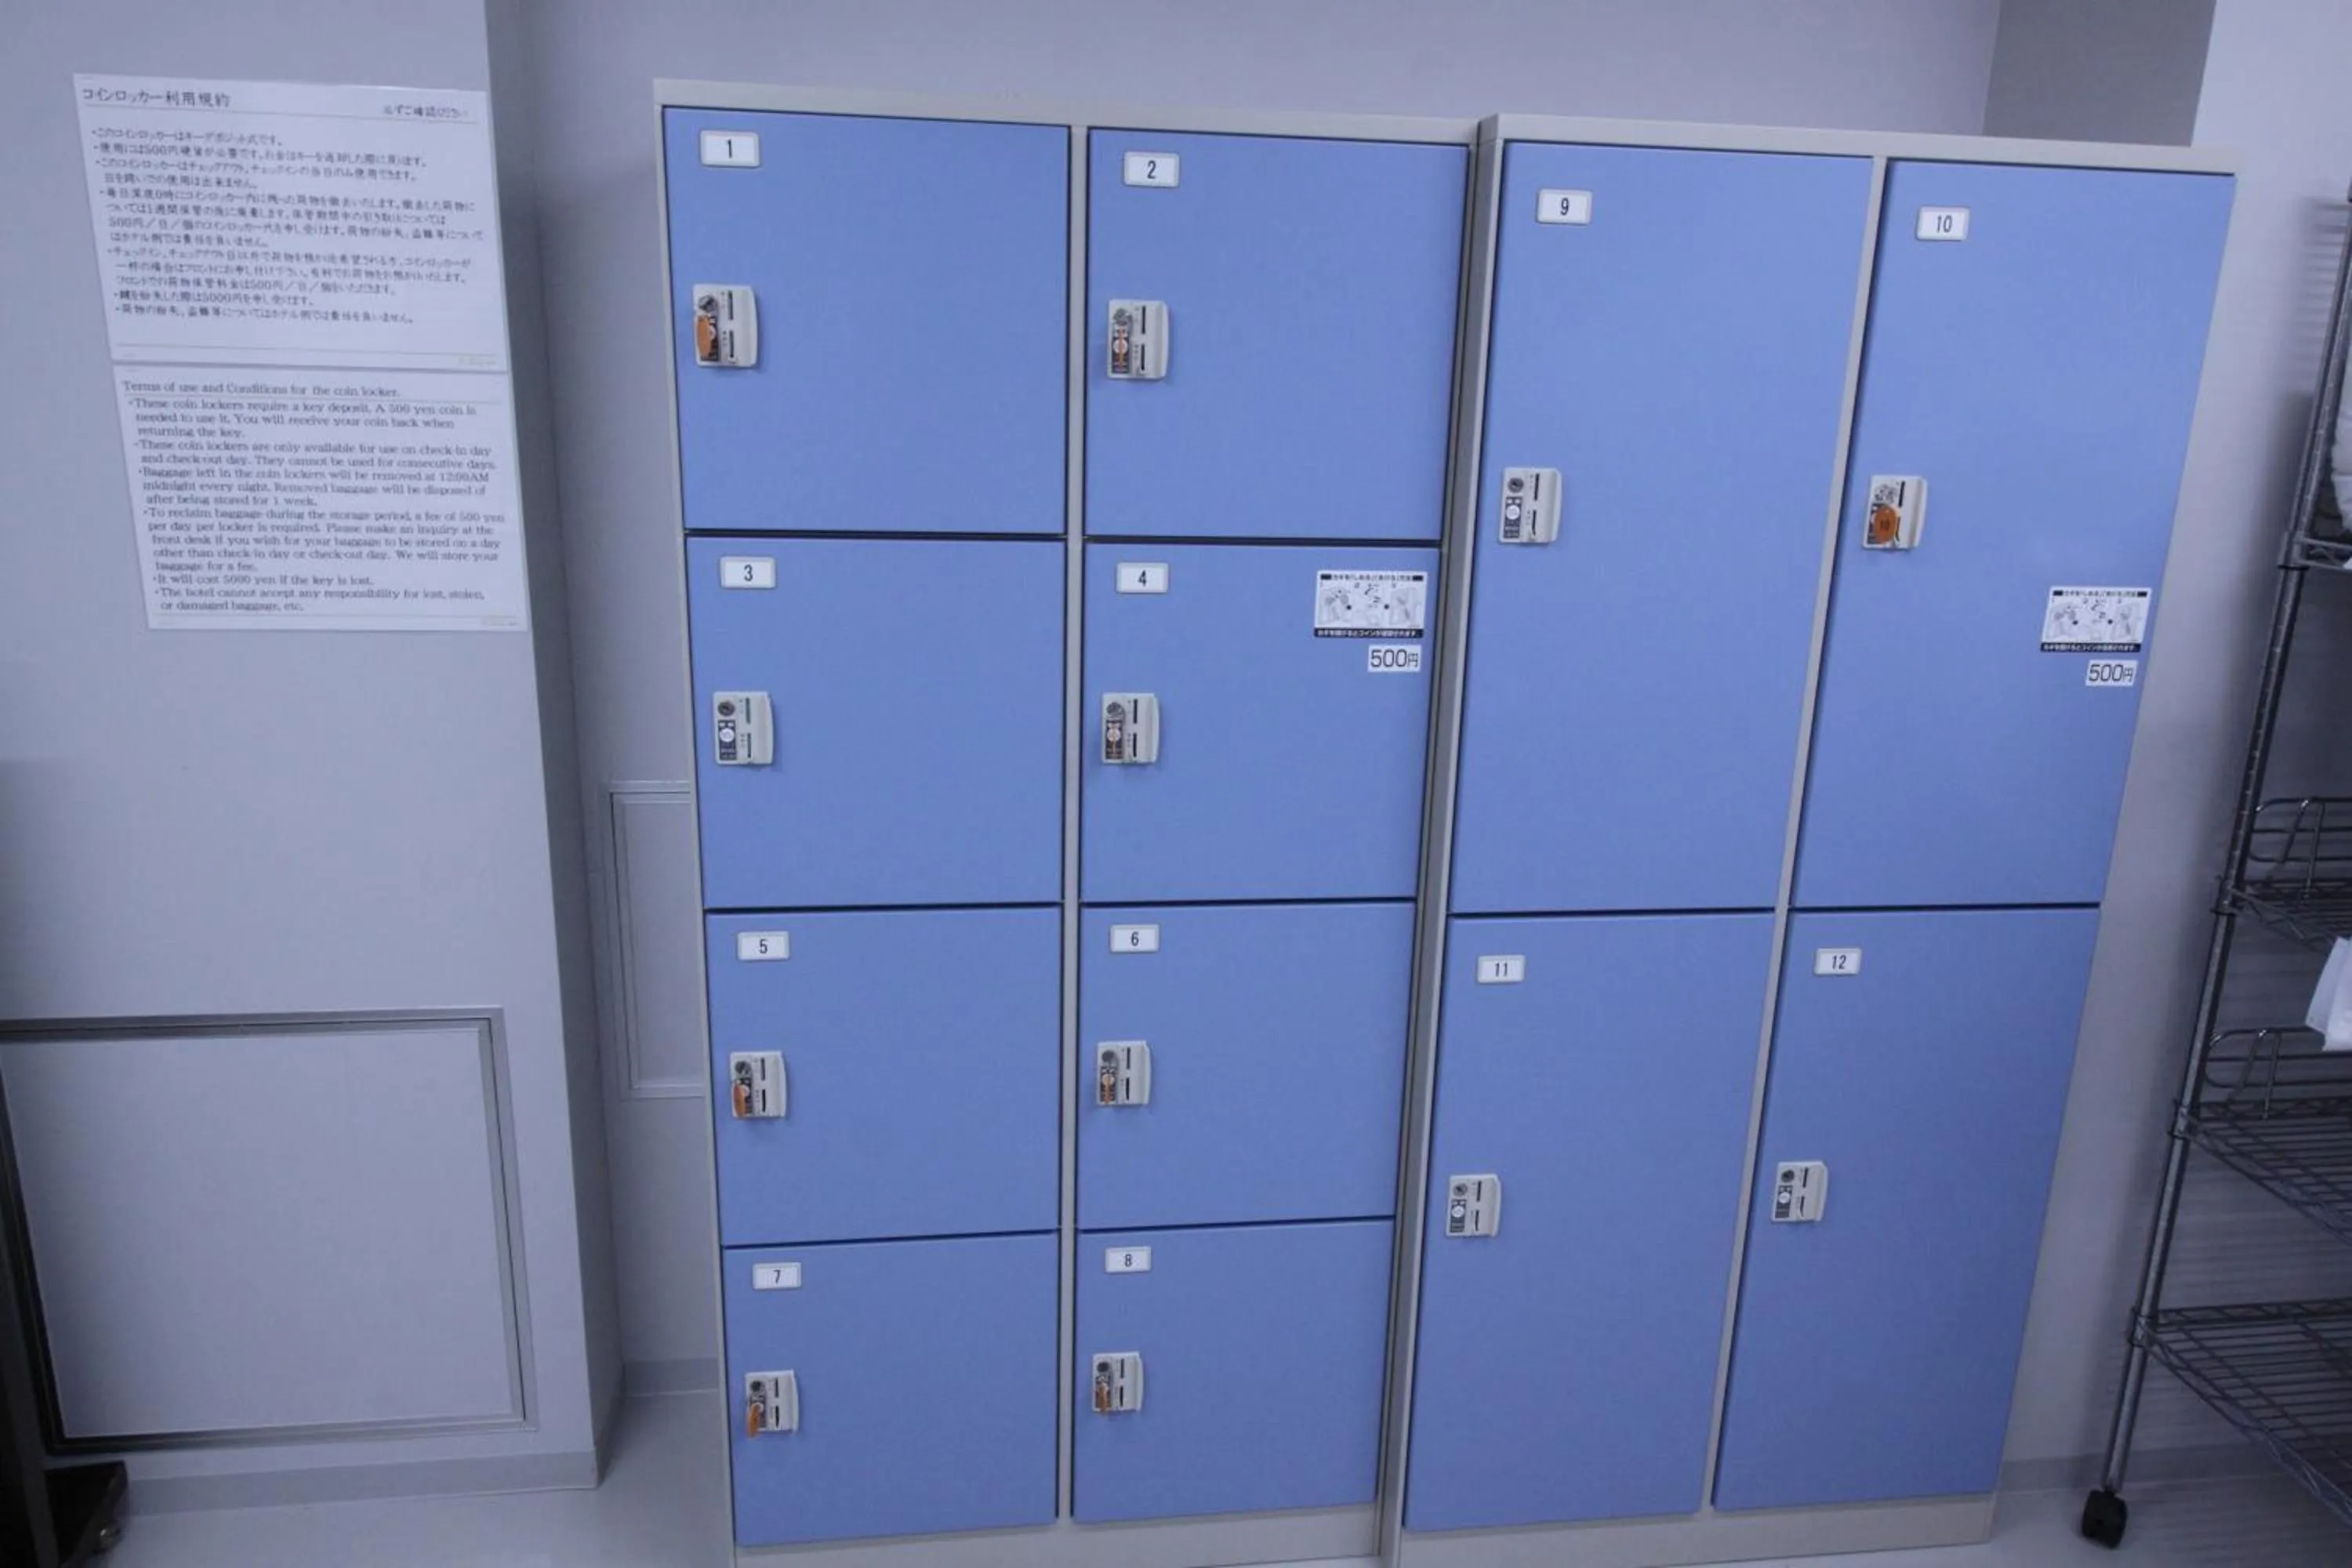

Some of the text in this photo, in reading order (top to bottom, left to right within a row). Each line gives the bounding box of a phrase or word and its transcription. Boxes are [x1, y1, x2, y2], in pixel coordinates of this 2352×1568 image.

[727, 139, 733, 158] 1
[1147, 160, 1156, 180] 2
[1560, 197, 1570, 216] 9
[1937, 215, 1952, 233] 10
[123, 382, 162, 392] Terms
[162, 383, 176, 392] of
[200, 383, 224, 393] and
[225, 383, 288, 394] Conditions
[289, 385, 307, 394] for
[311, 385, 330, 395] the
[332, 386, 360, 396] coin
[133, 398, 463, 416] These coin lockers require key 500 yen coin
[135, 412, 178, 423] needed
[178, 413, 194, 423] to
[232, 414, 260, 424] You
[261, 415, 285, 424] will
[288, 415, 330, 425] receive
[332, 418, 361, 427] your
[363, 416, 389, 426] coin
[390, 416, 419, 426] back
[421, 417, 454, 427] when
[136, 426, 216, 438] returning the
[139, 440, 175, 450] These
[176, 441, 204, 450] coin
[205, 441, 249, 451] lockers
[272, 442, 301, 453] only
[303, 442, 356, 452] available
[358, 443, 376, 453] for
[468, 445, 492, 456] day
[140, 454, 394, 467] and They cannot be used for
[143, 467, 436, 481] Baggage left in the coin lockers will be removed at
[142, 481, 486, 495] midnight every Removed baggage will be disposed of
[145, 494, 318, 506] after being stored for week.
[147, 507, 505, 523] To reclaim baggage during the storage fee of 500 yen
[147, 523, 167, 532] per
[169, 521, 192, 532] day
[195, 524, 216, 532] per
[217, 521, 253, 532] locker
[256, 522, 268, 532] is
[324, 523, 362, 532] Please
[365, 524, 397, 533] make
[416, 524, 459, 535] inquiry
[461, 524, 474, 534] at
[475, 524, 494, 534] the
[151, 535, 182, 544] front
[183, 535, 211, 544] desk
[227, 537, 250, 546] you
[252, 535, 281, 545] wish
[283, 535, 300, 545] for
[303, 539, 332, 547] your
[333, 536, 381, 548] baggage
[383, 537, 397, 546] to
[397, 537, 412, 546] be
[414, 537, 450, 546] stored
[478, 538, 500, 549] day
[152, 547, 185, 557] other
[187, 548, 214, 557] than
[267, 549, 290, 560] day
[395, 550, 412, 559] We
[416, 550, 438, 560] will
[440, 550, 470, 560] store
[471, 553, 499, 562] your
[154, 561, 224, 572] baggage for
[744, 564, 753, 583] 3
[169, 574, 334, 586] will cost 5000 yen the key
[1138, 570, 1147, 586] 4
[159, 587, 419, 600] The hotel cannot accept any responsibility for
[175, 601, 229, 612] damaged
[282, 601, 304, 610] etc.
[1370, 649, 1419, 668] 500円
[2089, 664, 2133, 682] 500円
[759, 938, 768, 954] 5
[1131, 931, 1139, 947] 6
[1495, 962, 1508, 977] 11
[1832, 954, 1847, 970] 12
[1124, 1254, 1132, 1268] 8
[773, 1269, 782, 1283] 7
